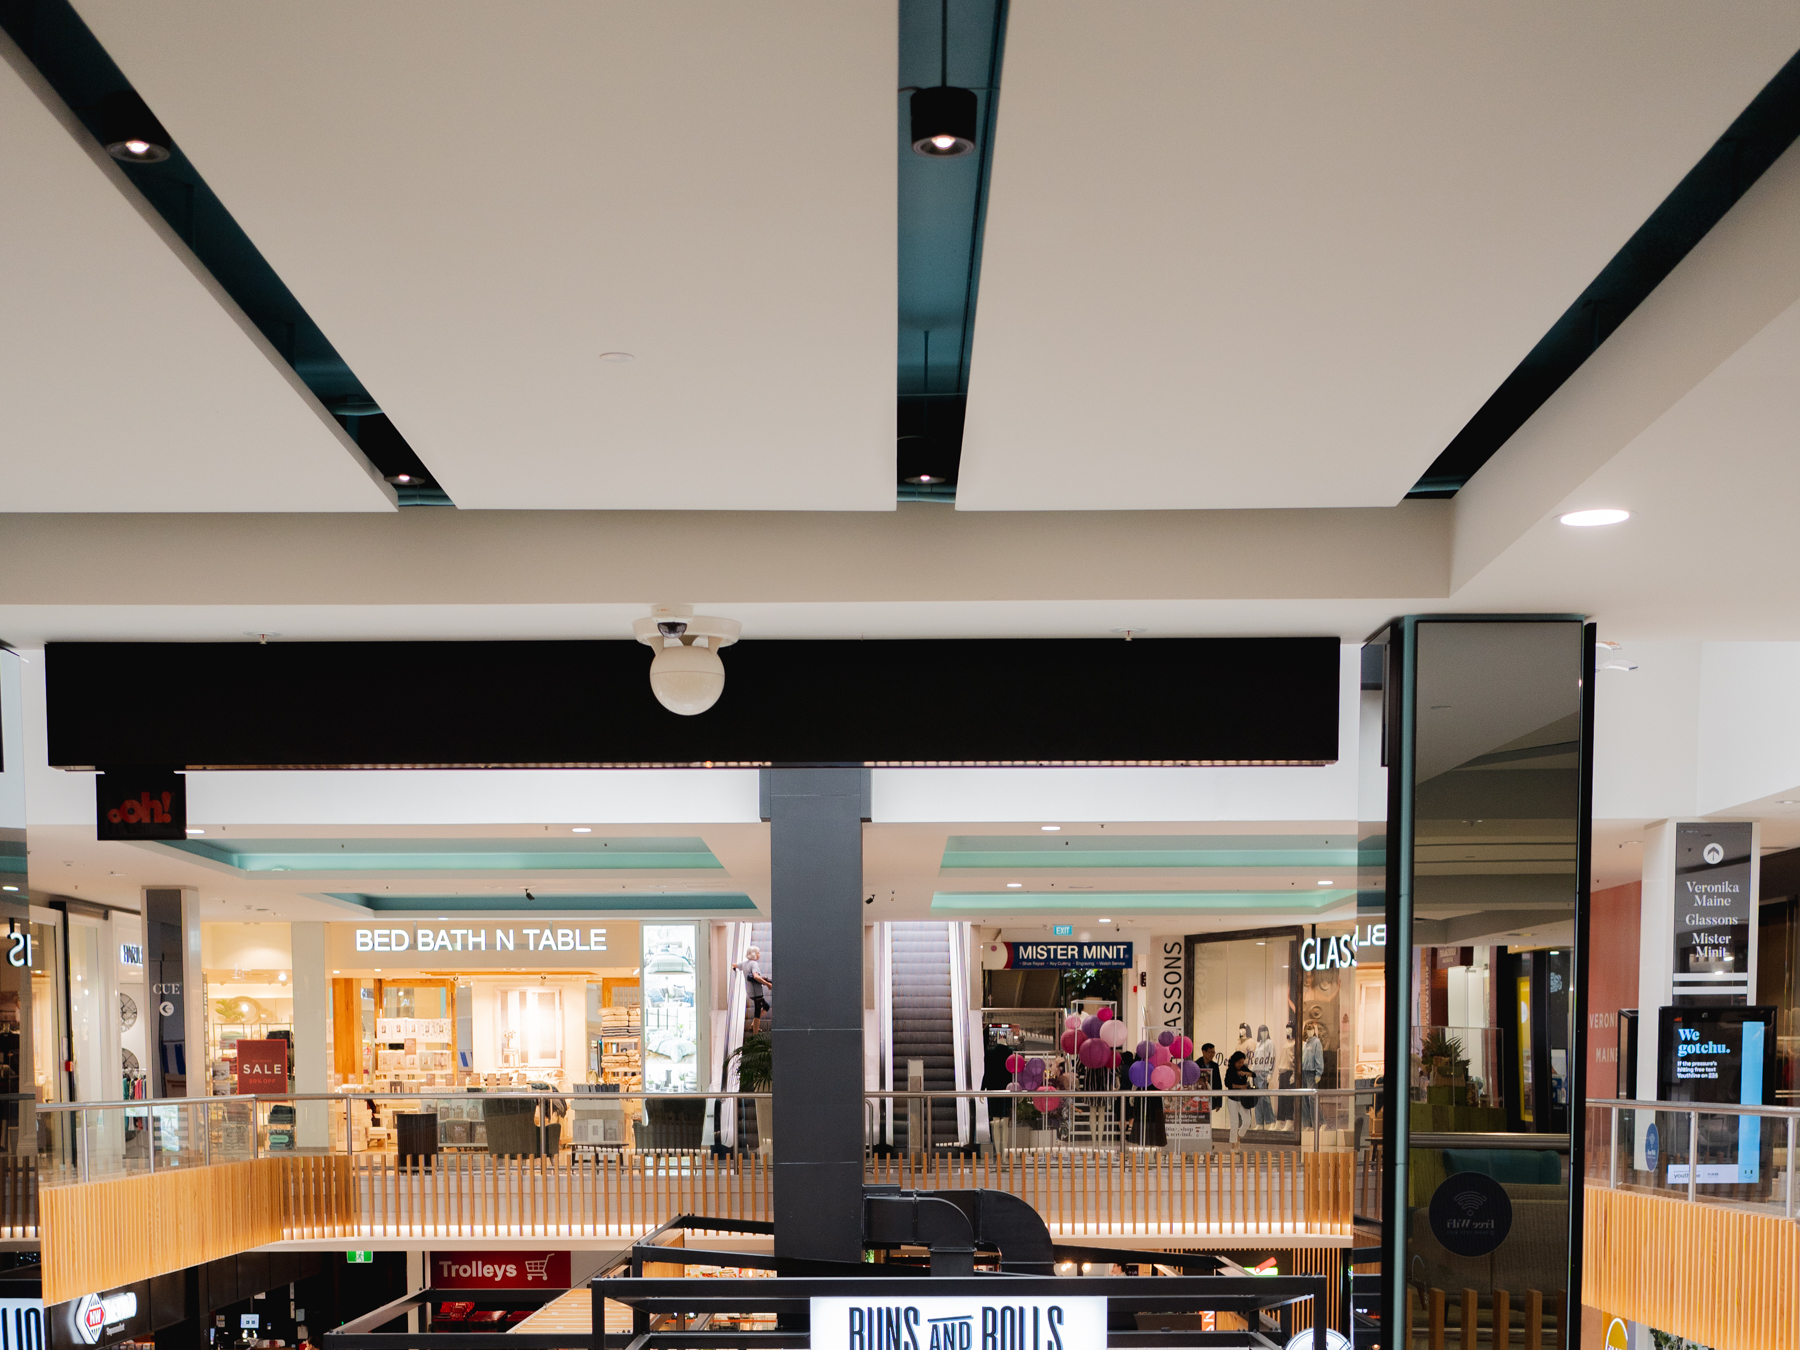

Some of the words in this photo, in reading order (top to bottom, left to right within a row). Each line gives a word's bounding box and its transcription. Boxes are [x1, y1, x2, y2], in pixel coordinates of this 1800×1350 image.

[1686, 881, 1740, 893] Veronika
[1694, 895, 1731, 906] Maine
[1686, 914, 1738, 926] Glassons
[1056, 926, 1070, 934] EXIT
[356, 930, 410, 951] BED
[418, 930, 486, 951] BATH
[496, 929, 514, 951] N
[523, 929, 607, 951] TABLE
[1692, 932, 1731, 944] Mister
[1020, 946, 1078, 959] MISTER
[1084, 946, 1127, 959] MINIT
[1696, 946, 1726, 958] Minit
[153, 984, 180, 994] CUE
[1164, 942, 1182, 1027] ASSONS
[1590, 1012, 1617, 1028] VERONI
[1678, 1028, 1700, 1041] We
[1678, 1041, 1730, 1058] gotchu.
[1247, 1051, 1275, 1071] Ready
[243, 1064, 281, 1074] SALE
[439, 1261, 517, 1281] Trolleys
